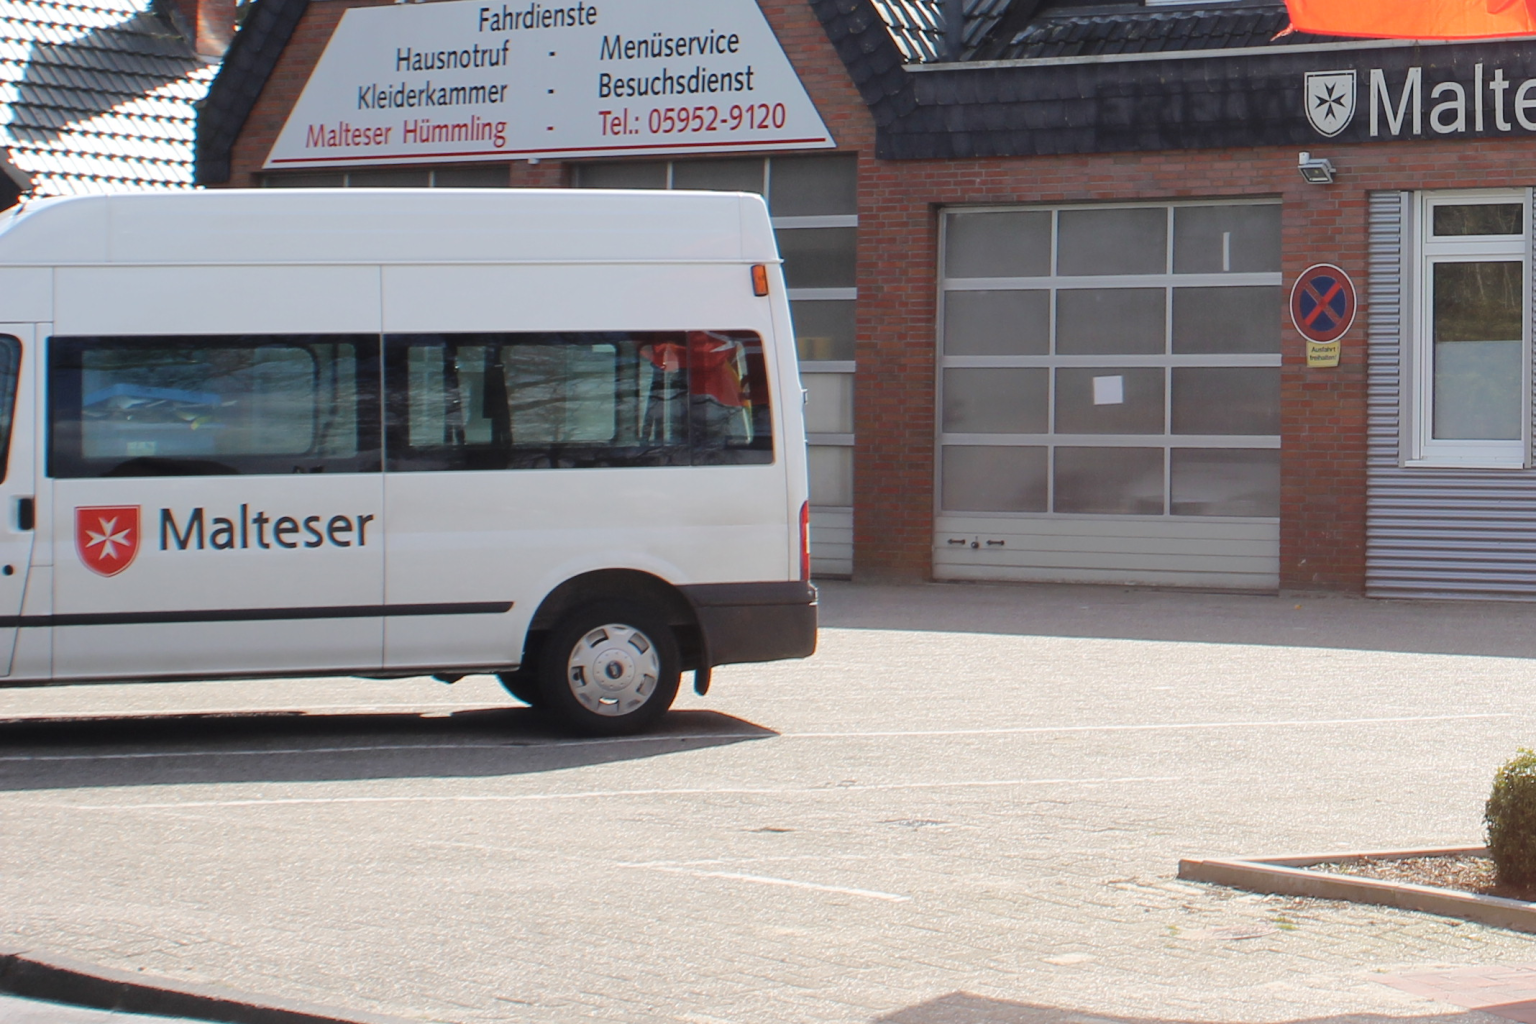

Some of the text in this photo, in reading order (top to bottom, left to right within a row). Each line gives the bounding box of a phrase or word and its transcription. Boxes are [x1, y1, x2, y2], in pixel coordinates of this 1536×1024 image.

[478, 1, 599, 33] Fahrdienste
[395, 39, 511, 73] Hausnotruf
[599, 29, 741, 63] Menüservice
[356, 79, 509, 111] Kleiderkammer
[597, 65, 756, 100] Besuchsdienst
[304, 122, 393, 149] Malteser
[401, 114, 508, 149] Hümmling
[598, 109, 640, 138] Tel.:
[647, 102, 787, 136] 05952-9120
[158, 502, 375, 551] Malteser
